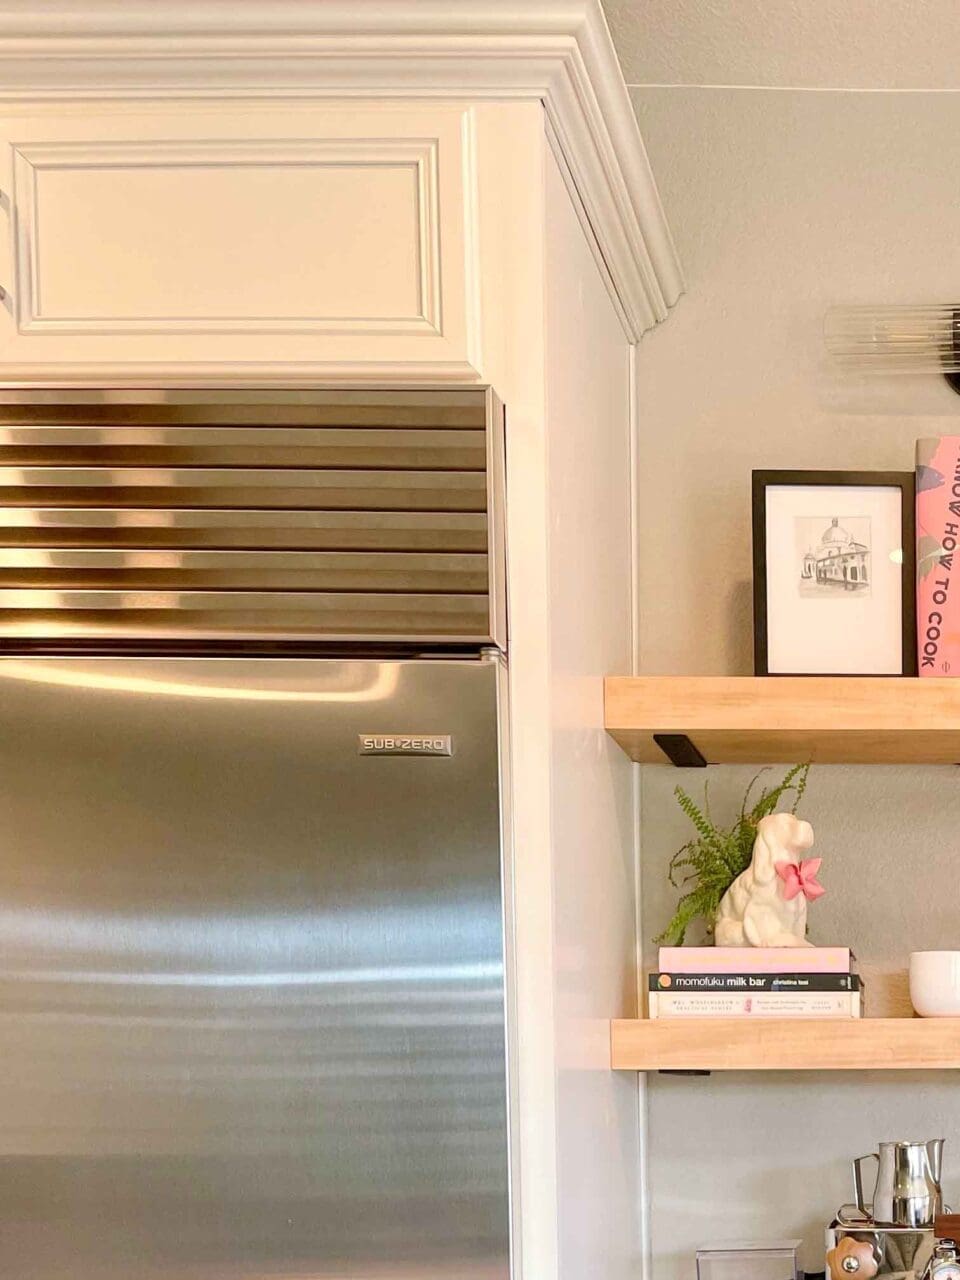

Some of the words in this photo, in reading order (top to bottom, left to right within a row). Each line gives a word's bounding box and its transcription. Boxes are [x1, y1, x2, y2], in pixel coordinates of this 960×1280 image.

[938, 522, 959, 571] HOW
[932, 578, 950, 605] TO
[921, 611, 942, 668] COOK
[675, 976, 725, 986] momofuku
[727, 976, 747, 986] milk
[749, 976, 766, 986] bar
